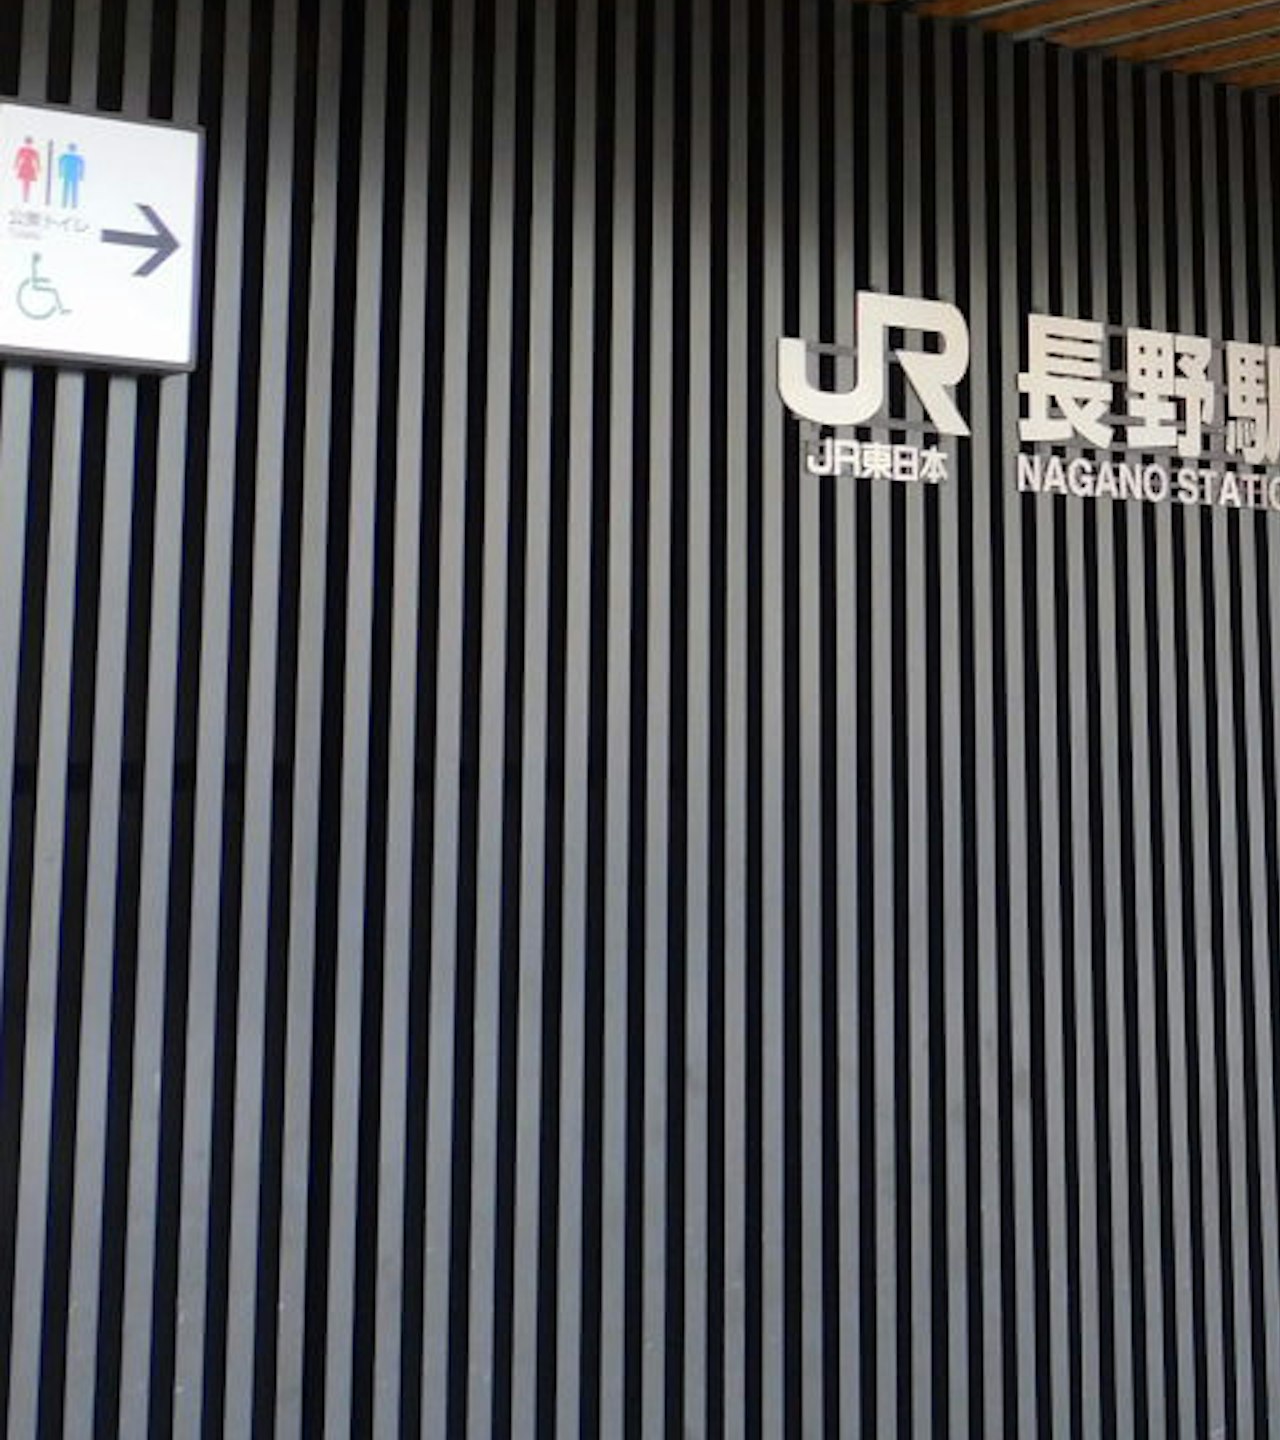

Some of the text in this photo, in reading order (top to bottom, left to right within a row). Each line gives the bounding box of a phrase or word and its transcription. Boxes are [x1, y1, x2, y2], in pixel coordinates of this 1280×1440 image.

[777, 290, 971, 436] JR
[806, 437, 949, 484] JR東日本
[1017, 453, 1169, 503] NAGANO
